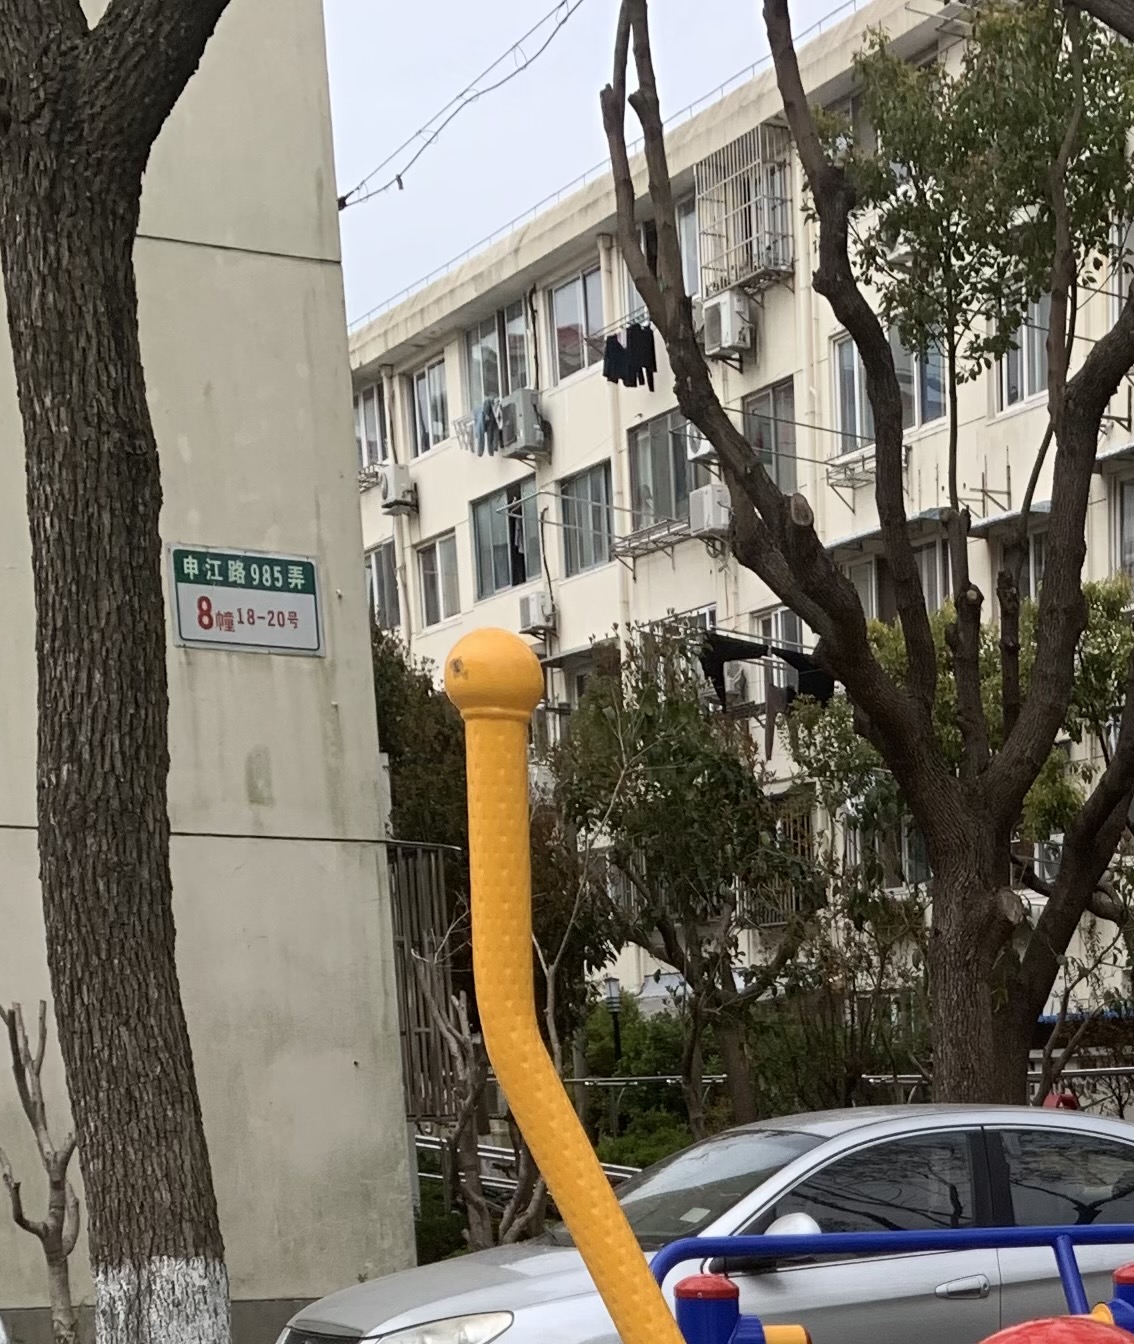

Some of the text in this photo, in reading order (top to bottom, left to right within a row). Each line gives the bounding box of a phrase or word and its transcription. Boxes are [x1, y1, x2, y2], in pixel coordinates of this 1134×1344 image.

[182, 555, 306, 590] 申江路985弄
[196, 595, 300, 633] 8幢18-20号
